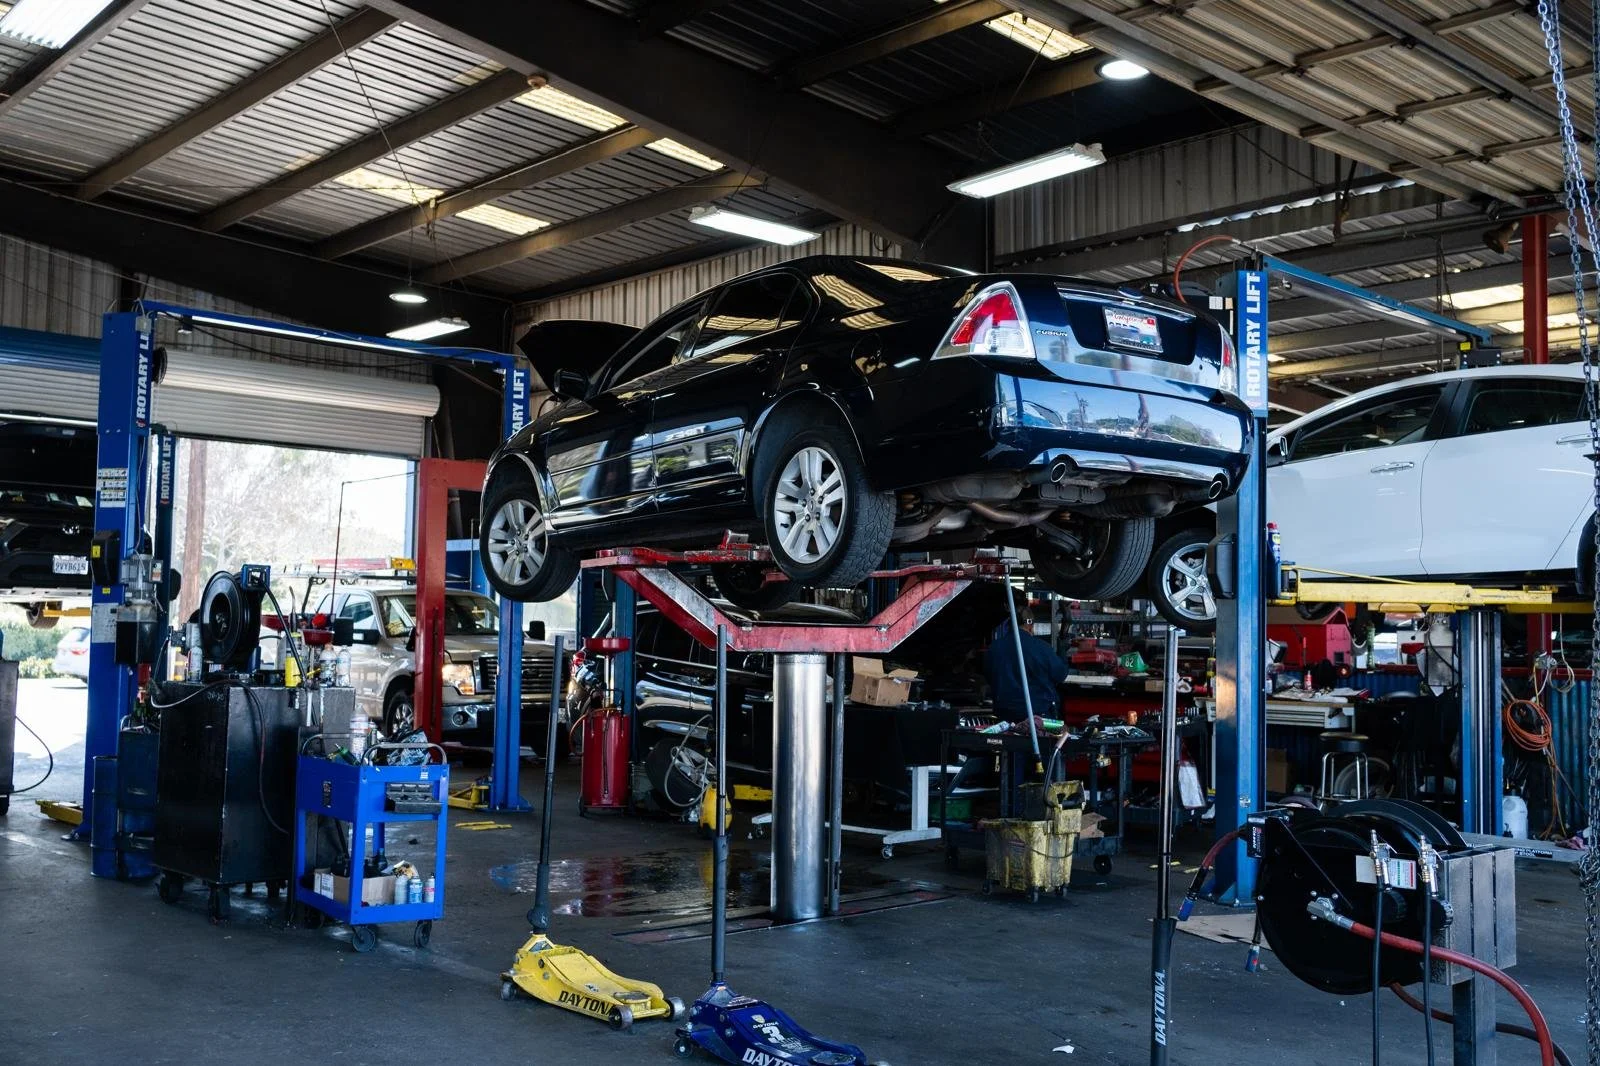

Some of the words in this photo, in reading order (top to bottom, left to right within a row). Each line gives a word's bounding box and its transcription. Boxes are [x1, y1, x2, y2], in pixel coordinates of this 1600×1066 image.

[1246, 273, 1261, 314] LIFT
[139, 332, 149, 350] LI
[1246, 318, 1261, 398] ROTARY
[136, 353, 148, 419] ROTARY
[513, 369, 525, 399] LIFT
[512, 403, 524, 434] ARY
[163, 436, 172, 457] LIFT
[161, 460, 171, 499] ROTARY
[1125, 657, 1134, 668] 82
[1154, 970, 1166, 1046] DAYTONA
[753, 1021, 779, 1029] DAYTONA
[762, 1026, 785, 1043] 3
